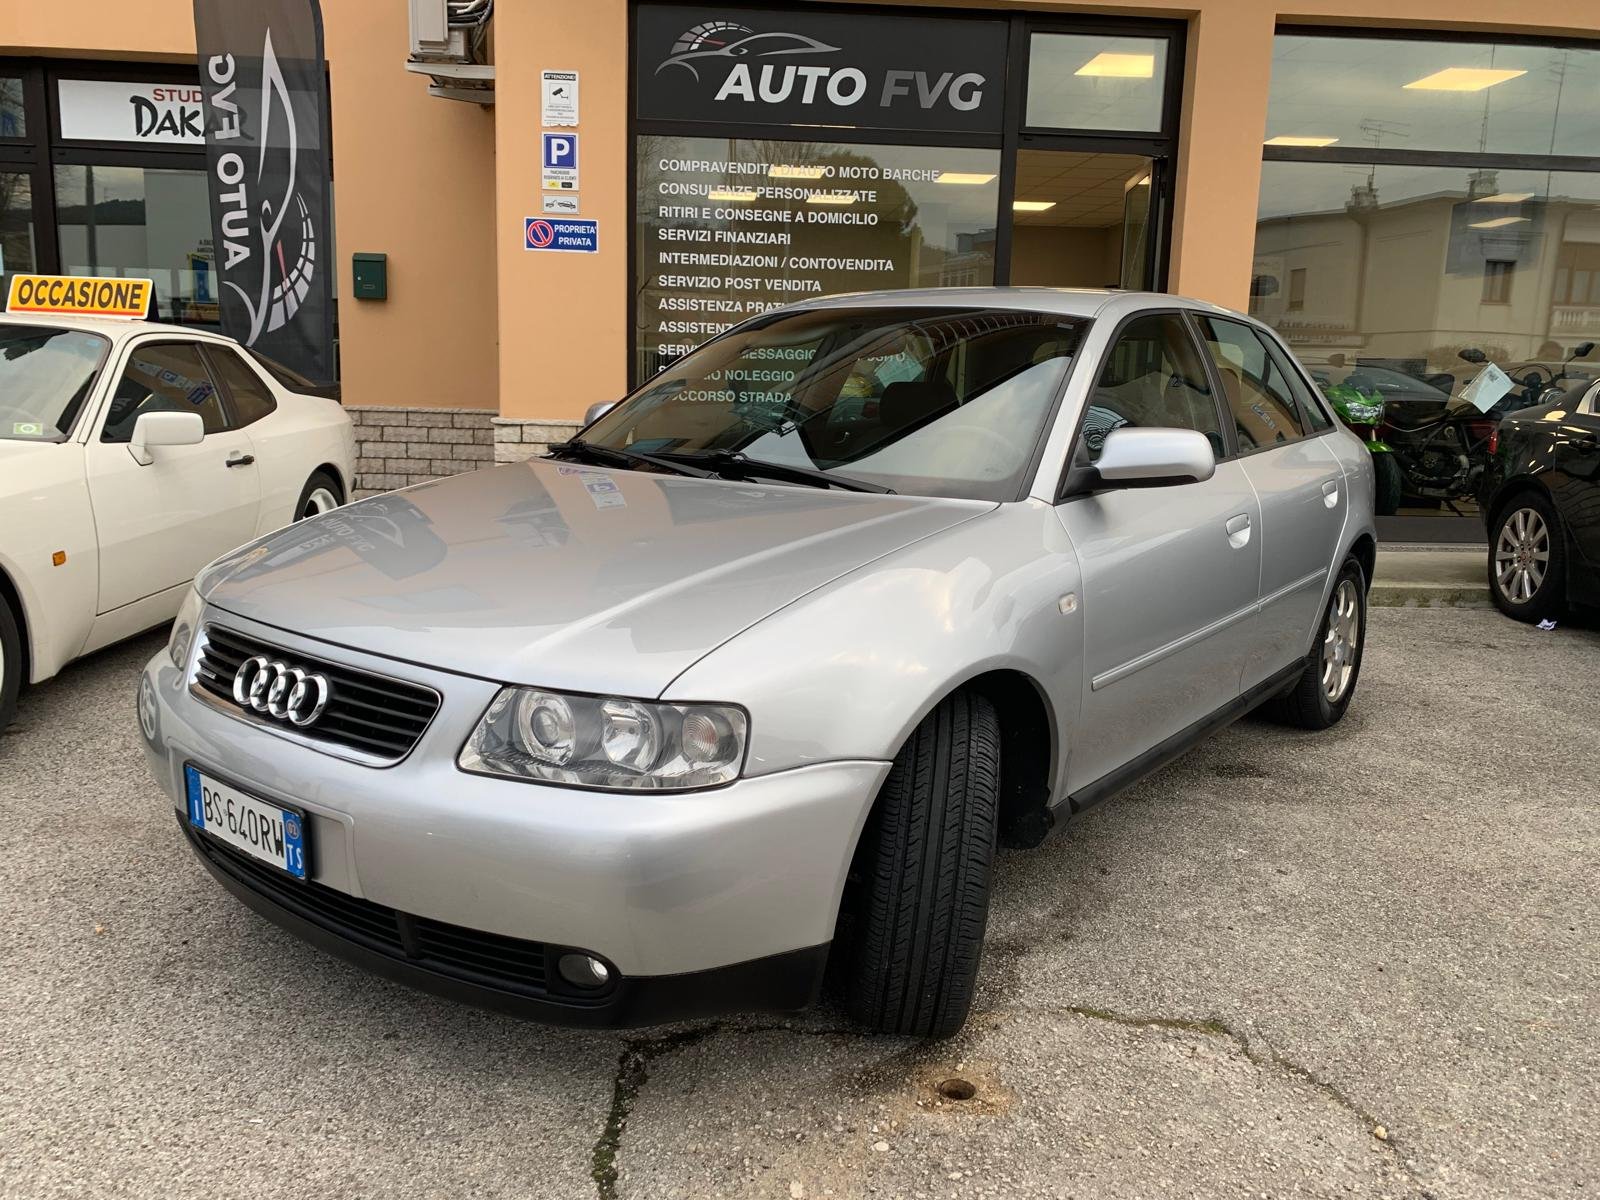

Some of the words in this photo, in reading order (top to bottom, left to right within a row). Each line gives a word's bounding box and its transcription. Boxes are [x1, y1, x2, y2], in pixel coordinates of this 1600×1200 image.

[153, 88, 204, 103] STUD
[714, 63, 867, 106] AUTO
[880, 69, 987, 112] FVG
[551, 138, 570, 165] P
[659, 159, 776, 176] COMPRAVENDITA
[781, 165, 794, 177] DI
[796, 165, 835, 178] AUTO
[839, 167, 878, 179] MOTO
[883, 168, 940, 182] BARCHE
[659, 183, 754, 198] CONSULENZE
[757, 187, 877, 203] PERSONALIZZATE
[659, 206, 698, 219] RITIRI
[702, 207, 711, 220] E
[715, 208, 792, 223] CONSEGNE
[795, 211, 805, 223] A
[808, 212, 878, 226] DOMICILIO
[558, 237, 592, 246] PRIVATA
[658, 228, 711, 242] SERVIZI
[715, 230, 791, 245] FINANZIARI
[659, 252, 778, 268] INTERMEDIAZIONI
[780, 257, 786, 268] /
[789, 257, 894, 271] CONTOVENDITA
[658, 275, 721, 289] SERVIZIO
[725, 276, 762, 290] POST
[765, 279, 821, 292] VENDITA
[18, 279, 143, 310] OCCASIONE
[658, 298, 743, 313] ASSISTENZA
[658, 321, 735, 335] ASSISTENZ
[725, 370, 795, 383] NOLEGGIO
[739, 390, 793, 403] STRADA
